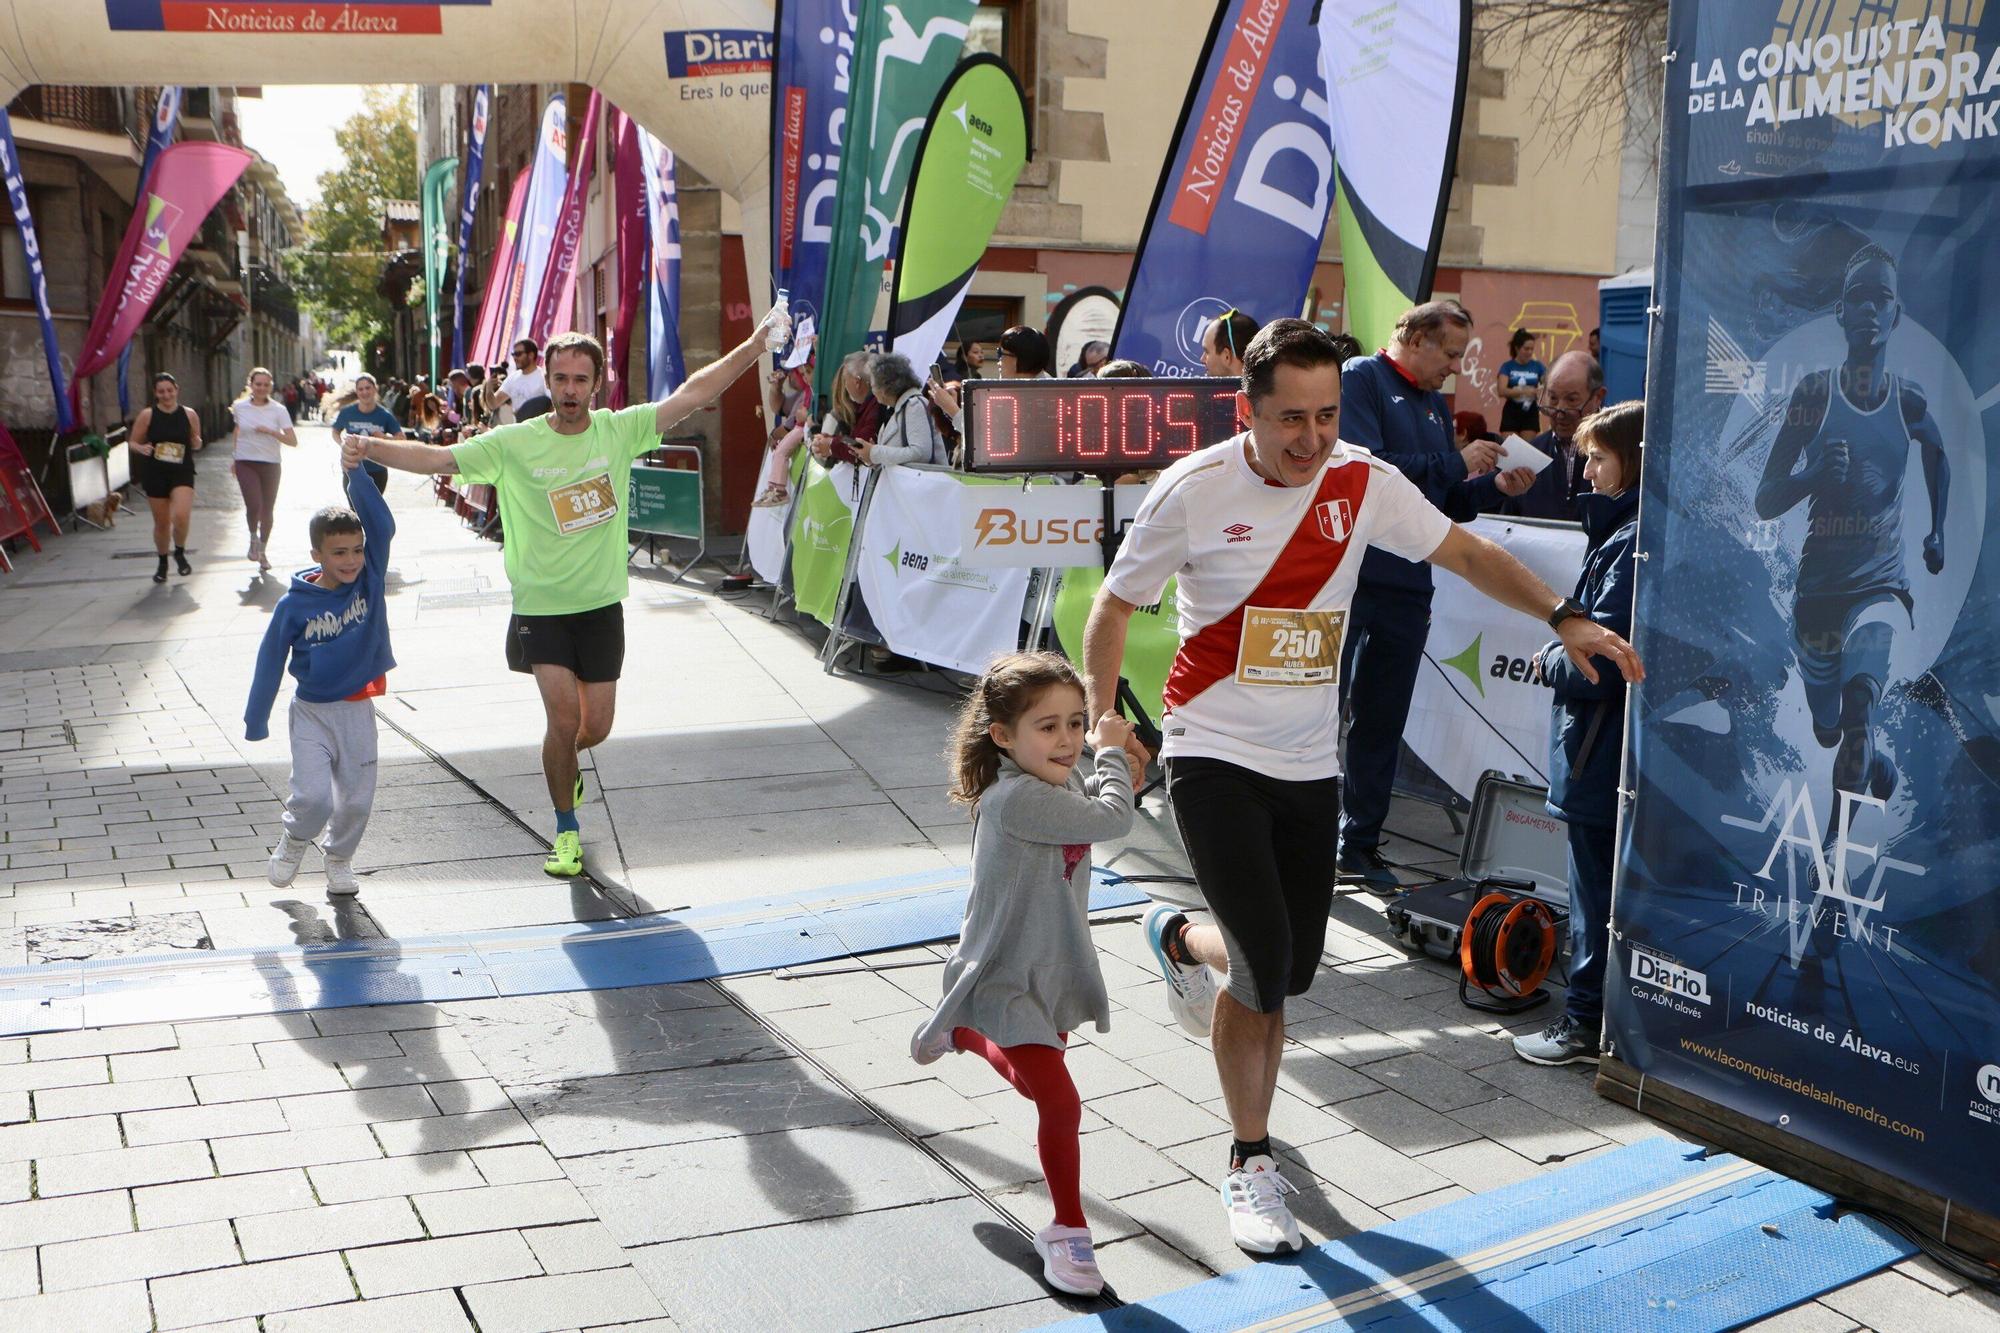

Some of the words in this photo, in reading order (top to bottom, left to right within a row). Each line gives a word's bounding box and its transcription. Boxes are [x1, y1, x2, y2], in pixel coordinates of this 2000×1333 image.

[206, 8, 295, 32] Noticias
[301, 10, 326, 32] de
[331, 4, 398, 32] Álava
[1690, 58, 1726, 89] LA
[1737, 15, 1947, 82] CONQUISTA
[680, 84, 714, 101] Eres
[720, 81, 733, 97] lo
[739, 82, 770, 101] que
[1688, 93, 1715, 115] DE
[1720, 87, 1746, 110] LA
[1745, 45, 2000, 127] ALMENDRA
[969, 114, 993, 137] aena
[1187, 95, 1244, 205] Noticias
[1228, 59, 1256, 92] de
[134, 258, 171, 305] kutxa
[570, 489, 601, 513] 313
[1226, 534, 1252, 544] umbro
[902, 551, 929, 571] aena
[1269, 628, 1323, 659] 250
[1732, 881, 1900, 952] TRIEVENT
[1637, 954, 1702, 997] Diario
[1631, 985, 1649, 1000] Con
[1651, 992, 1673, 1009] ADN
[1746, 1000, 1809, 1035] noticias
[1813, 1023, 1836, 1045] de
[1840, 1028, 1921, 1076] Álava.eus
[1679, 1035, 1926, 1143] www.laconquistadelaalmendra.com
